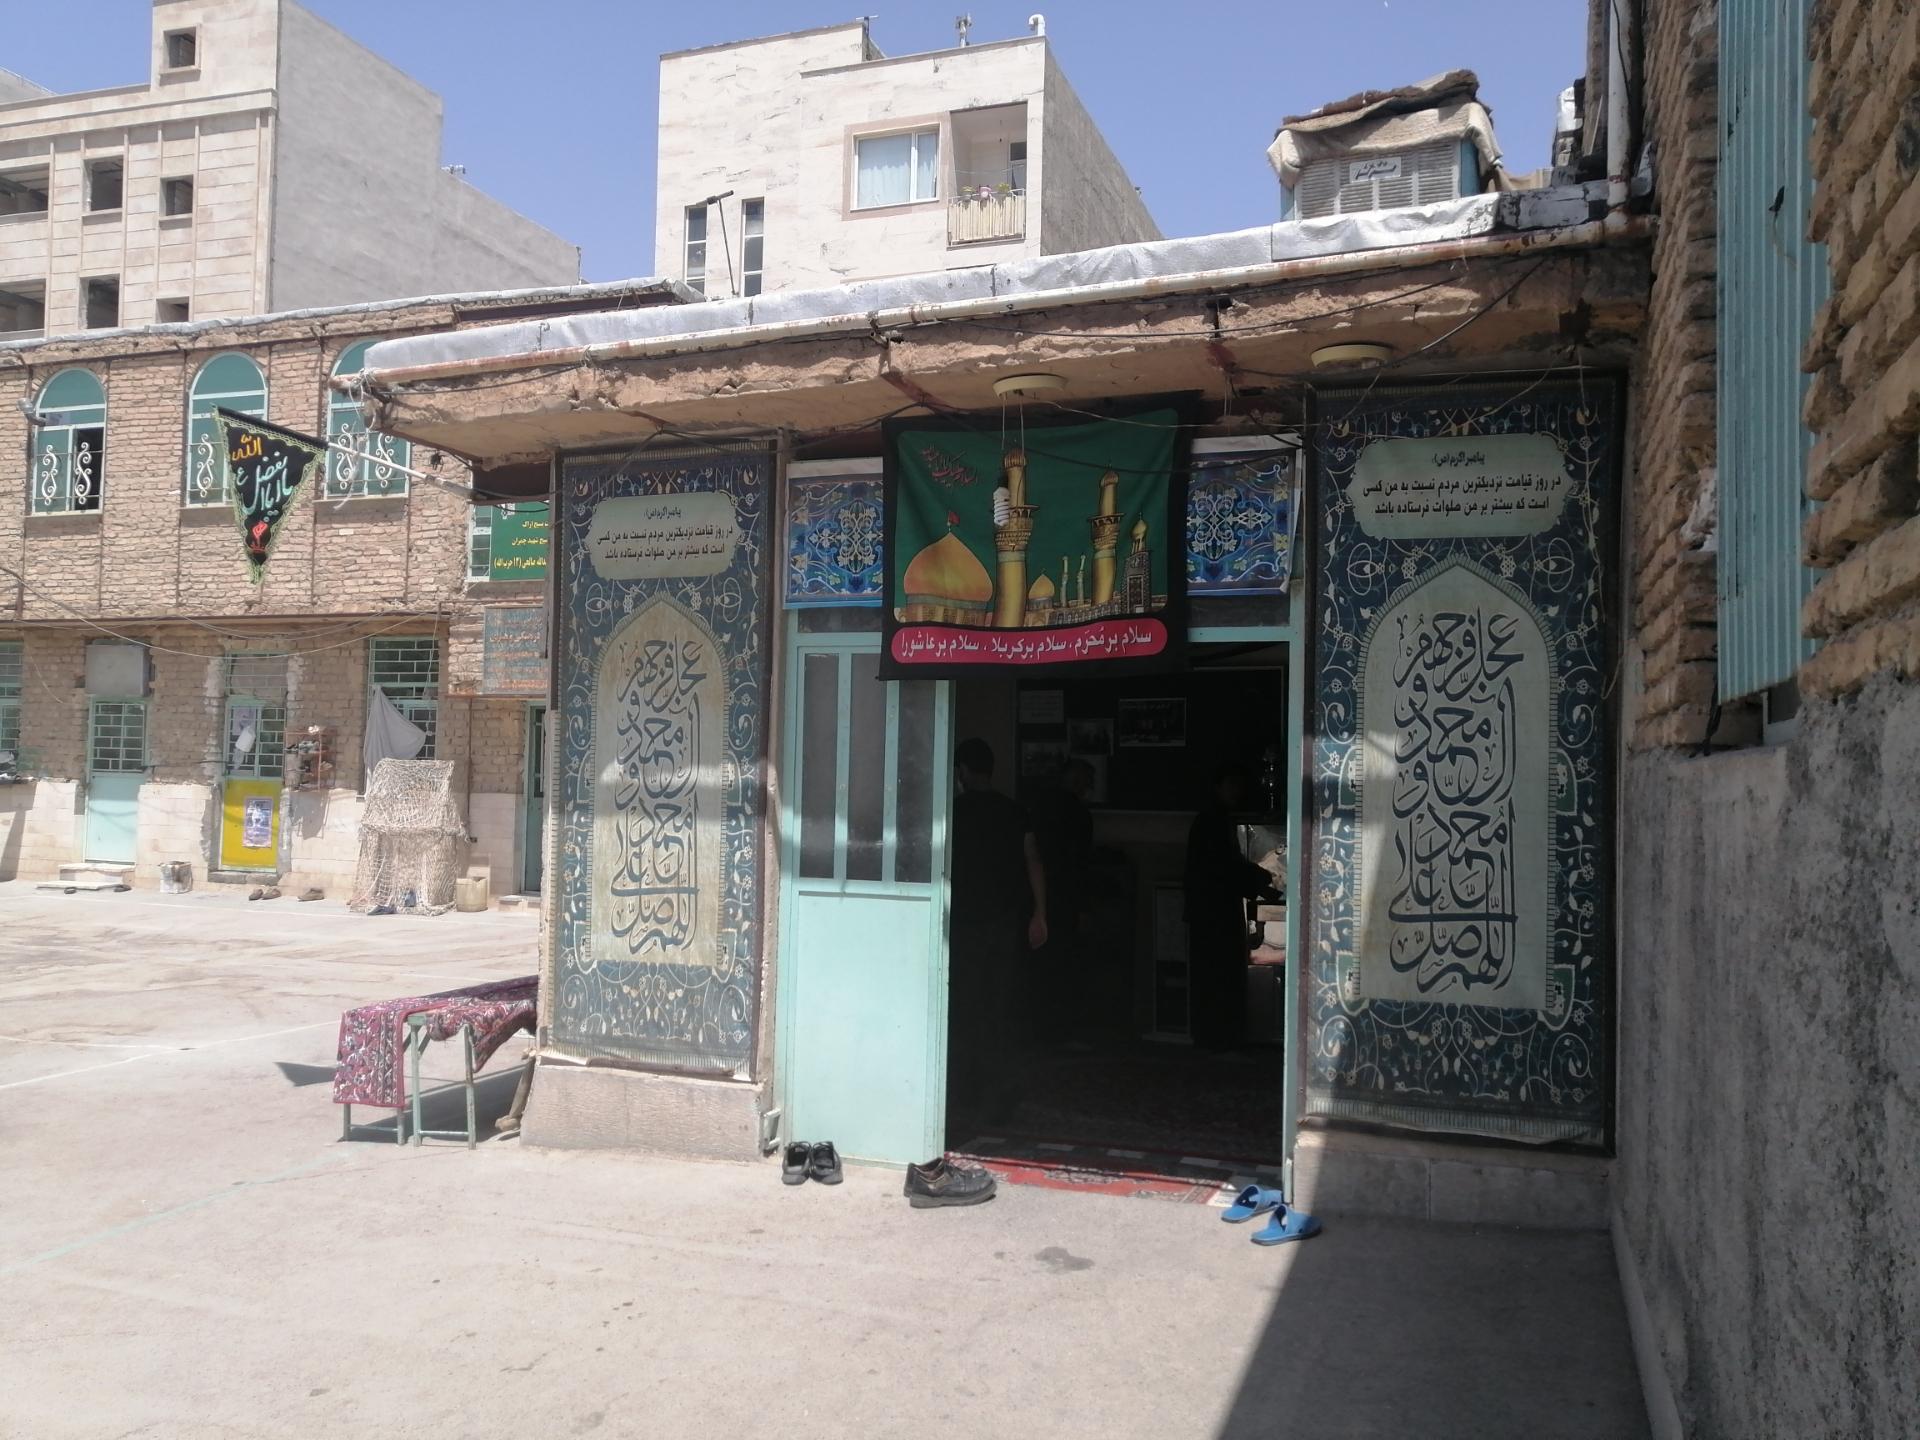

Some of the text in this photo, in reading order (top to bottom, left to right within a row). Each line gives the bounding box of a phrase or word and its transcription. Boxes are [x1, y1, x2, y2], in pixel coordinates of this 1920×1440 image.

[1363, 474, 1561, 497] در روز قیامت نزدیکترین مردم نسبت به من کسی
[1374, 496, 1550, 518] است که بیشتر بر من صلوات فرستاده باشد
[598, 531, 610, 545] کسی
[612, 534, 621, 544] من
[623, 532, 628, 543] به
[630, 529, 647, 542] نسبت
[648, 532, 664, 545] مردم
[695, 524, 714, 539] قیامت
[715, 525, 724, 539] روز
[726, 525, 733, 539] در
[605, 543, 725, 562] است که بیشتر بر من صلوات فرستاده باشد
[901, 633, 937, 657] عاشورا
[949, 635, 979, 658] سلام
[1105, 633, 1119, 652] بر
[1122, 624, 1152, 652] سلام
[936, 638, 947, 657] بر
[1021, 644, 1034, 659] بر
[1037, 636, 1066, 660] سلام
